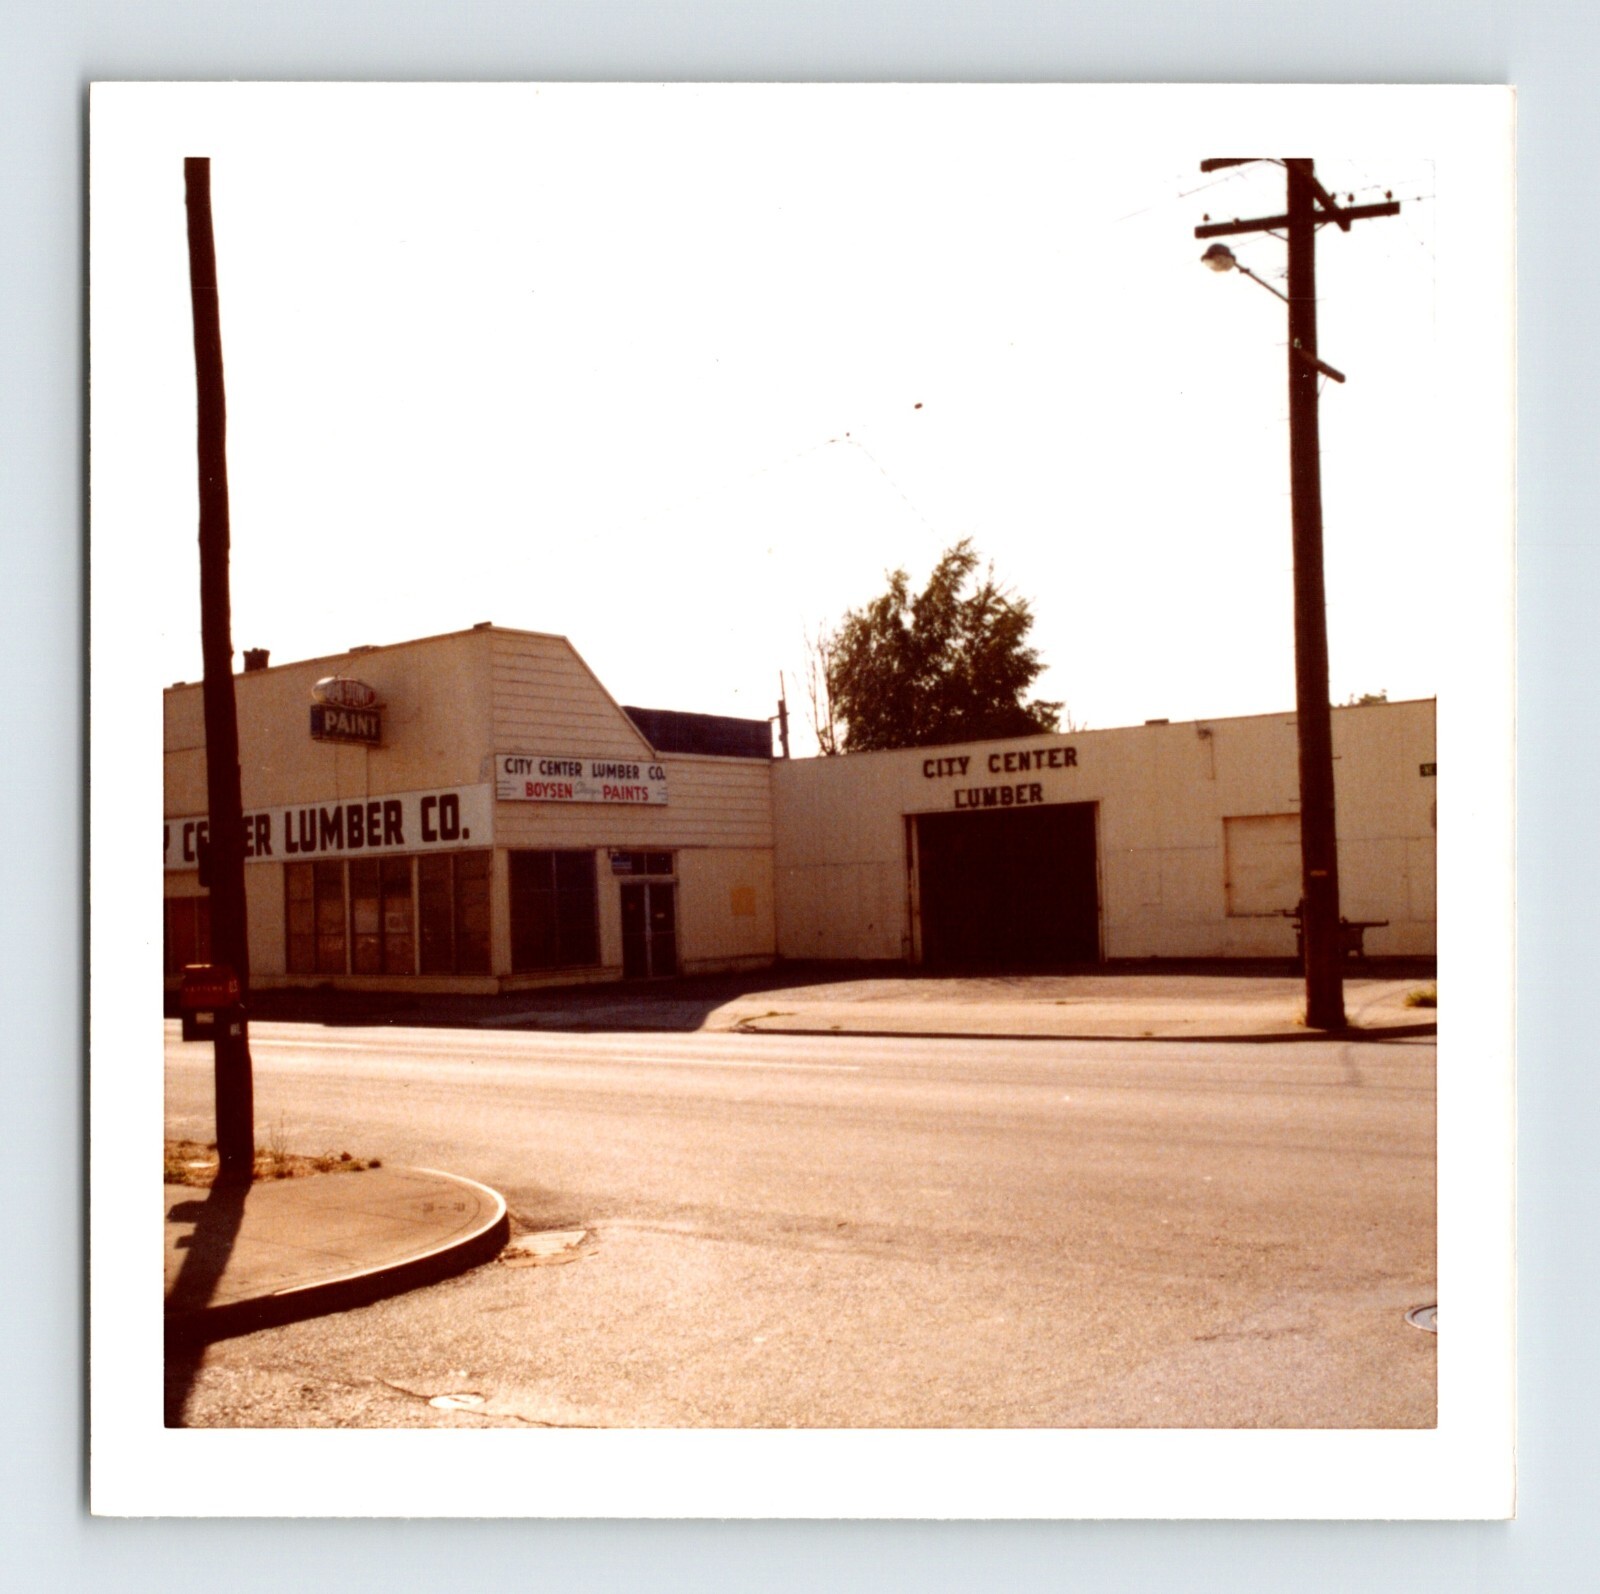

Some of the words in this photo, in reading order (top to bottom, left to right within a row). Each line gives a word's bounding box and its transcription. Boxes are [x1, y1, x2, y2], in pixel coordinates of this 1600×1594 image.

[325, 710, 378, 736] PAINT
[504, 757, 533, 775] CITY
[539, 760, 583, 778] CENTER
[592, 763, 640, 780] LUMBER
[648, 766, 666, 781] CO.
[922, 756, 971, 779] CITY
[987, 747, 1078, 774] CENTER
[525, 781, 573, 799] BOYSEN
[602, 784, 649, 801] PAINTS
[953, 783, 1044, 809] LUMBER
[183, 813, 273, 862] CEER
[284, 799, 405, 855] LUMBER
[420, 793, 470, 843] CO.
